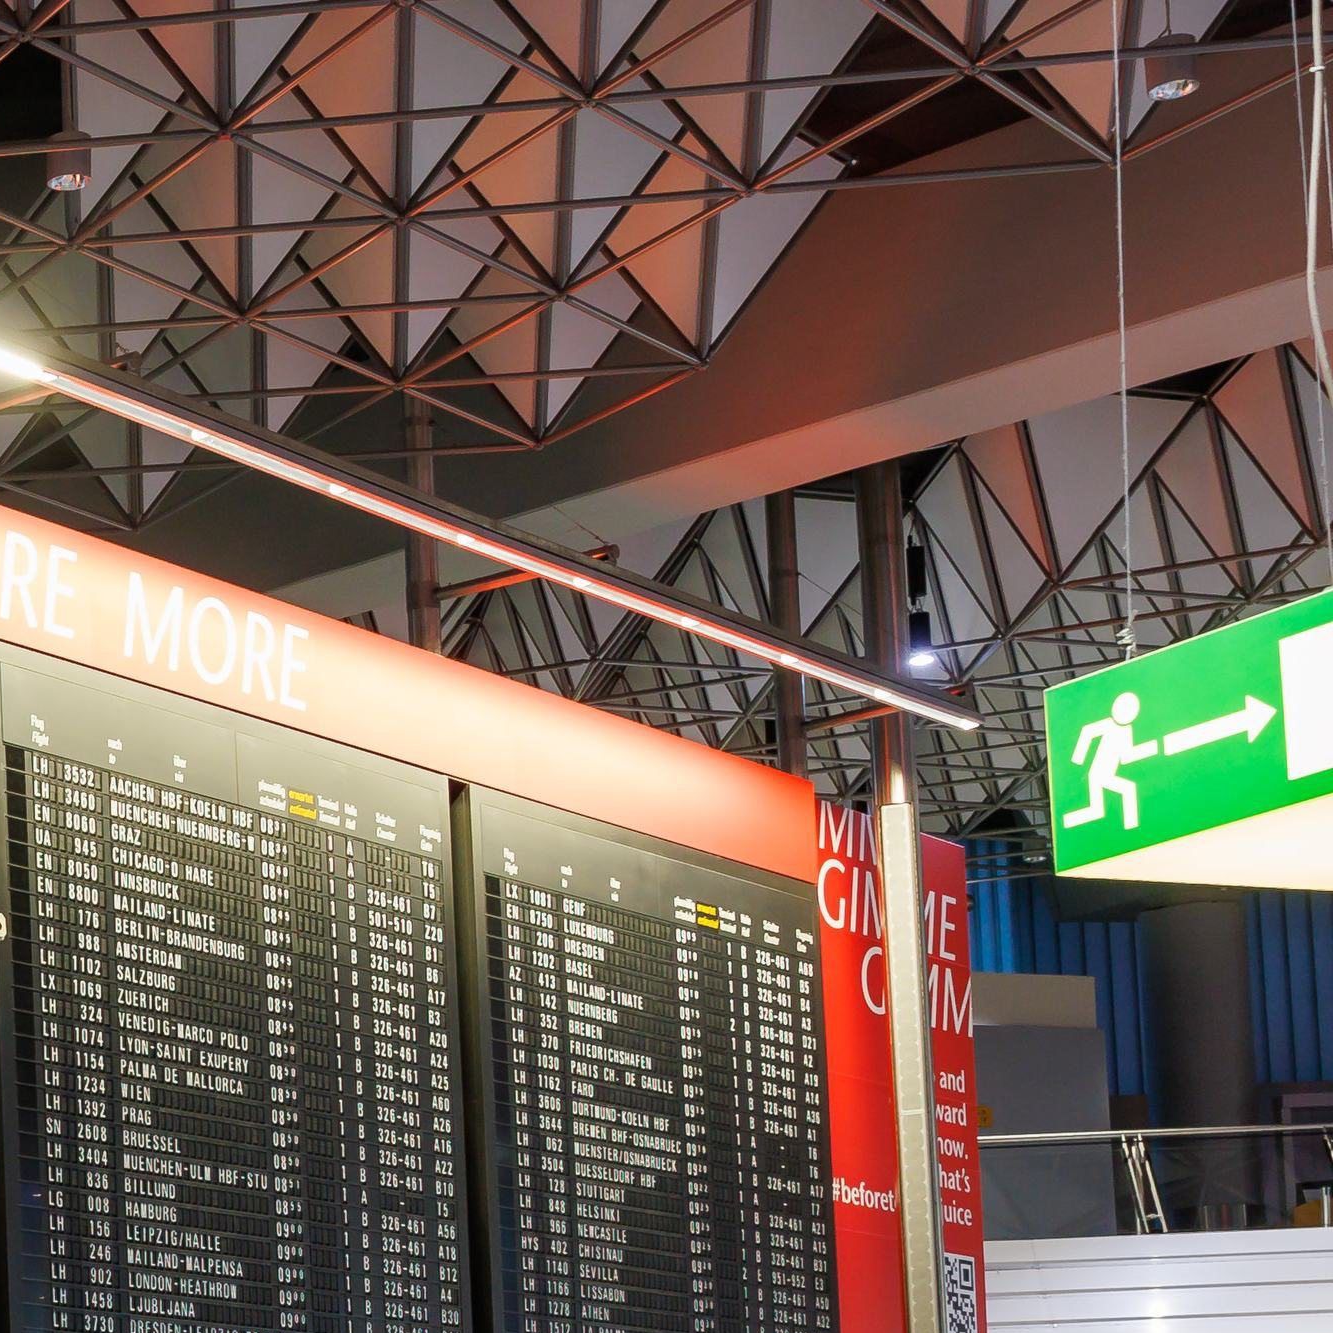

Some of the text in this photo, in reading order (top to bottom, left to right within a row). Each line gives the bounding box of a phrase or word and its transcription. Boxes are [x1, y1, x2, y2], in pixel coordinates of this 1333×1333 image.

[124, 571, 310, 712] MORE
[111, 824, 141, 845] GRAZ
[114, 871, 179, 900] INNSBRUCK
[116, 965, 175, 991] SALZBURG
[564, 960, 593, 978] BASEL
[571, 1082, 594, 1098] FARO
[940, 1070, 965, 1093] and
[121, 1107, 151, 1125] PRAG
[936, 1103, 966, 1126] ward
[122, 1130, 180, 1153] BRUESSEL
[124, 1177, 175, 1199] BILLUND
[939, 1164, 970, 1193] hat's
[576, 1204, 620, 1222] HELSINKI
[579, 1265, 618, 1281] SEVILLA
